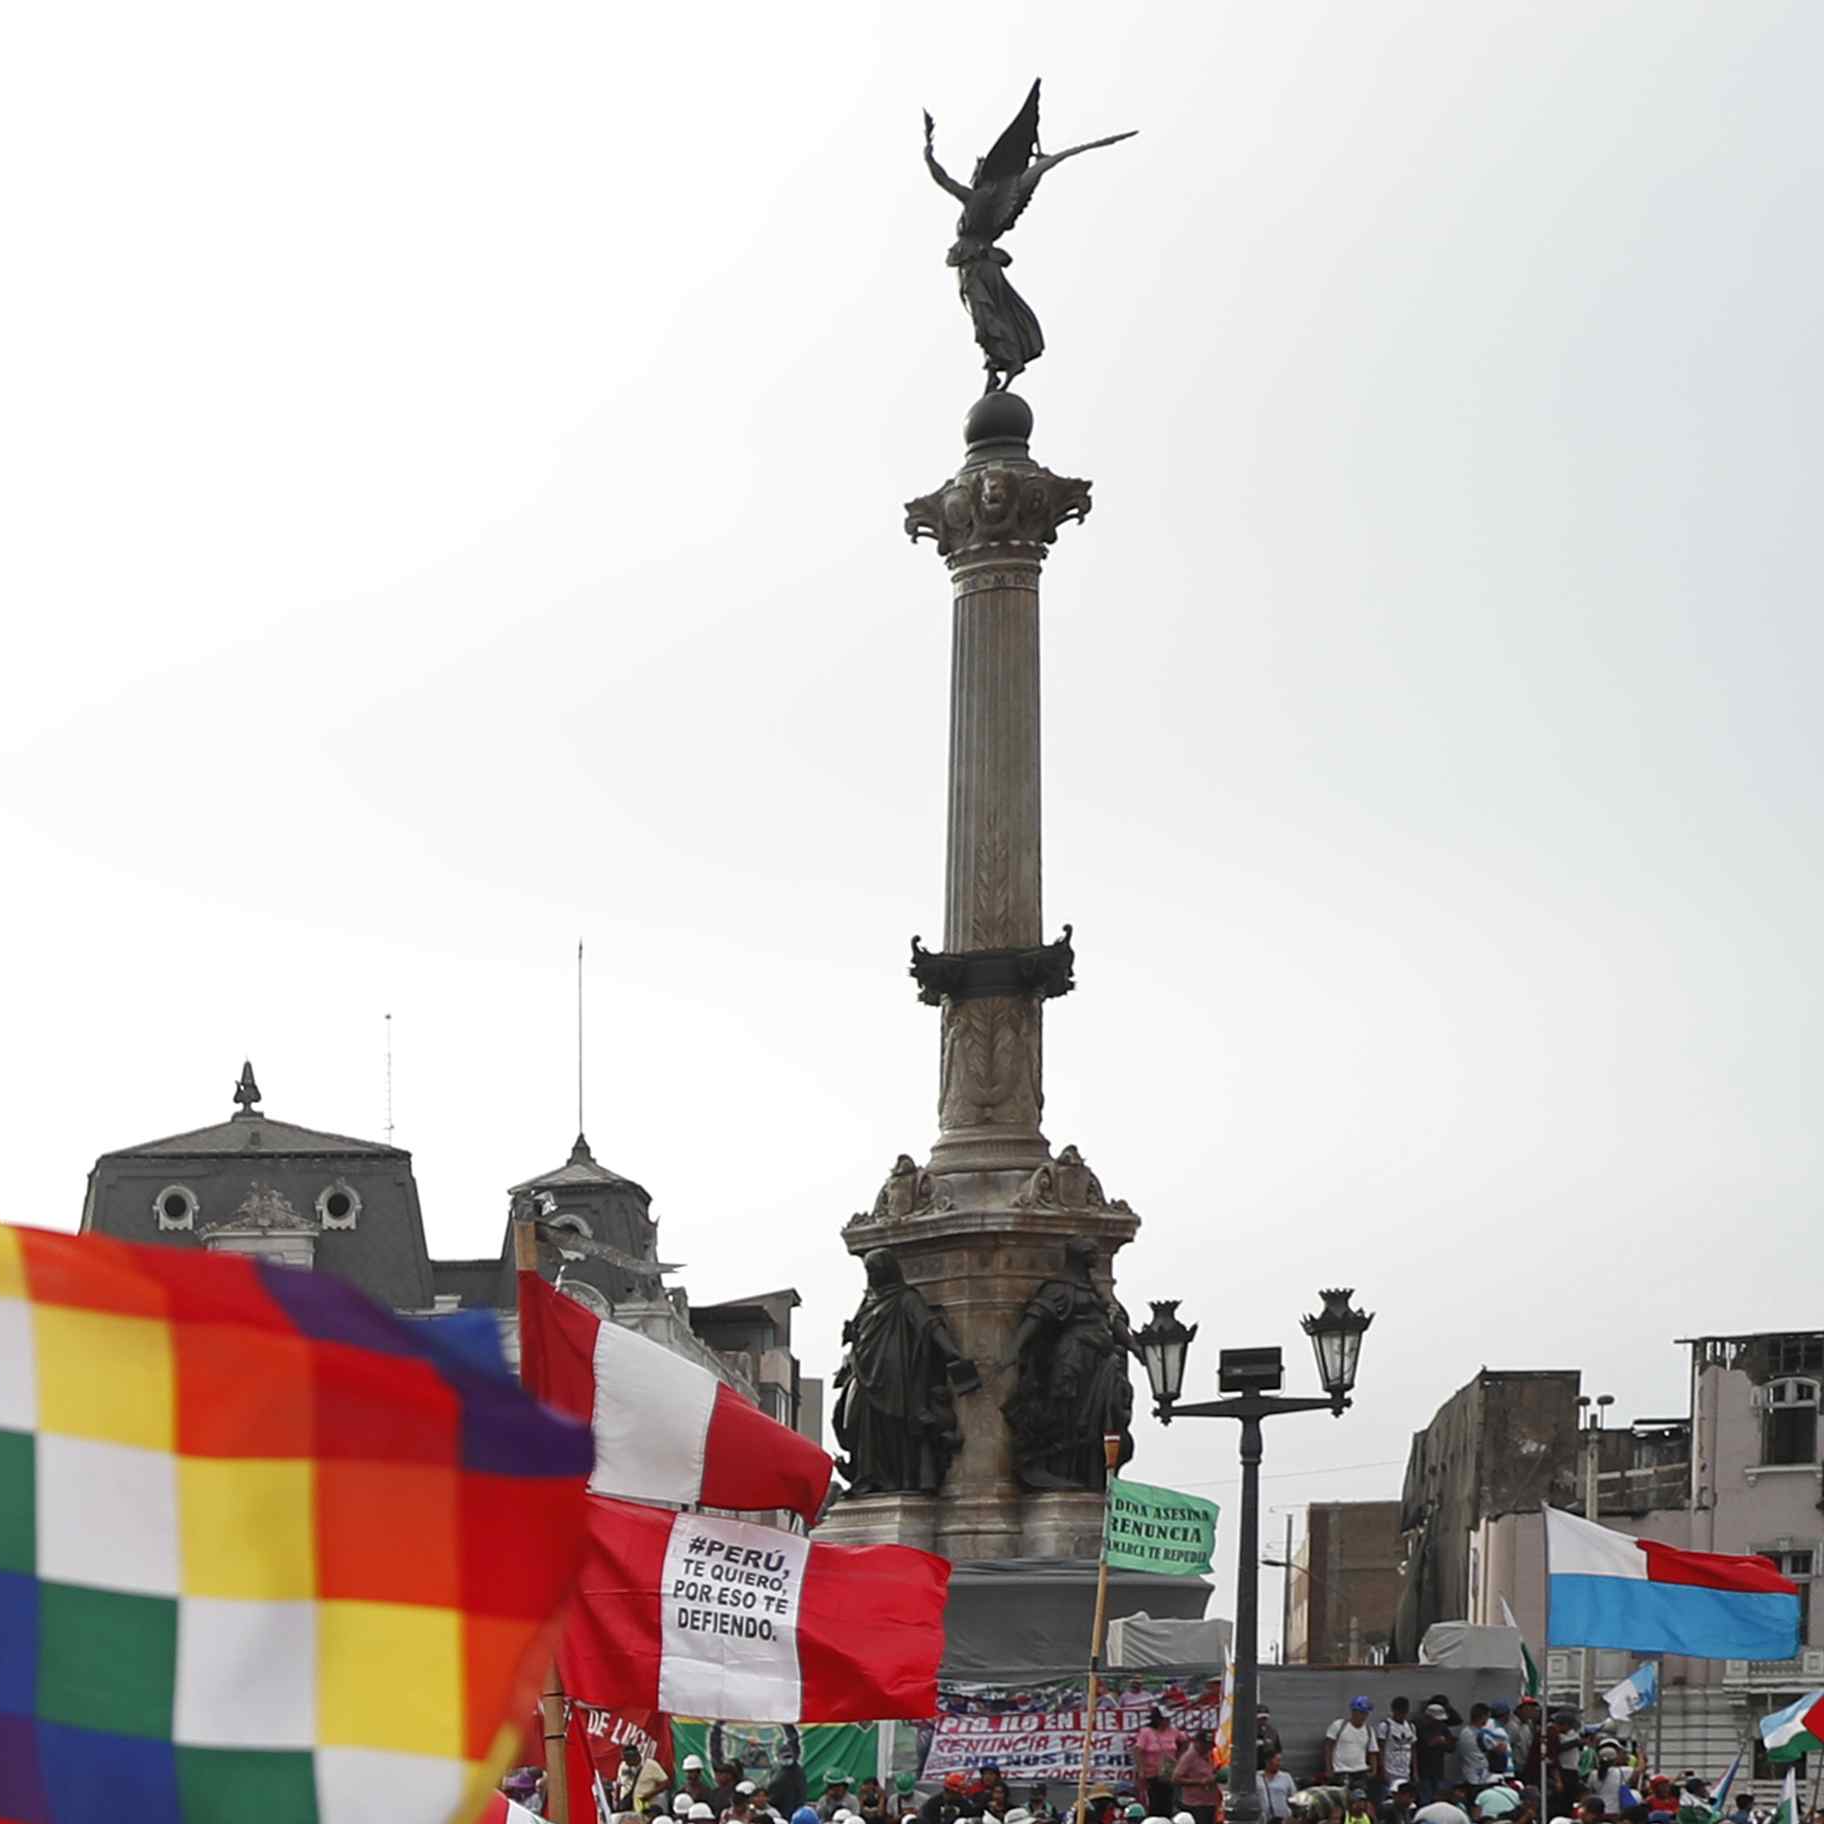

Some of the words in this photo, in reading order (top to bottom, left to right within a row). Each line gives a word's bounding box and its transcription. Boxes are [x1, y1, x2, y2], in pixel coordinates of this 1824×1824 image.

[688, 1536, 790, 1580] #PERÚ,
[683, 1558, 706, 1577] TE
[710, 1564, 788, 1596] QUIERO,
[673, 1579, 713, 1603] POR
[717, 1587, 757, 1609] ESO
[763, 1595, 789, 1615] TE
[677, 1607, 778, 1642] DEFIENDO.
[587, 1709, 611, 1737] DE
